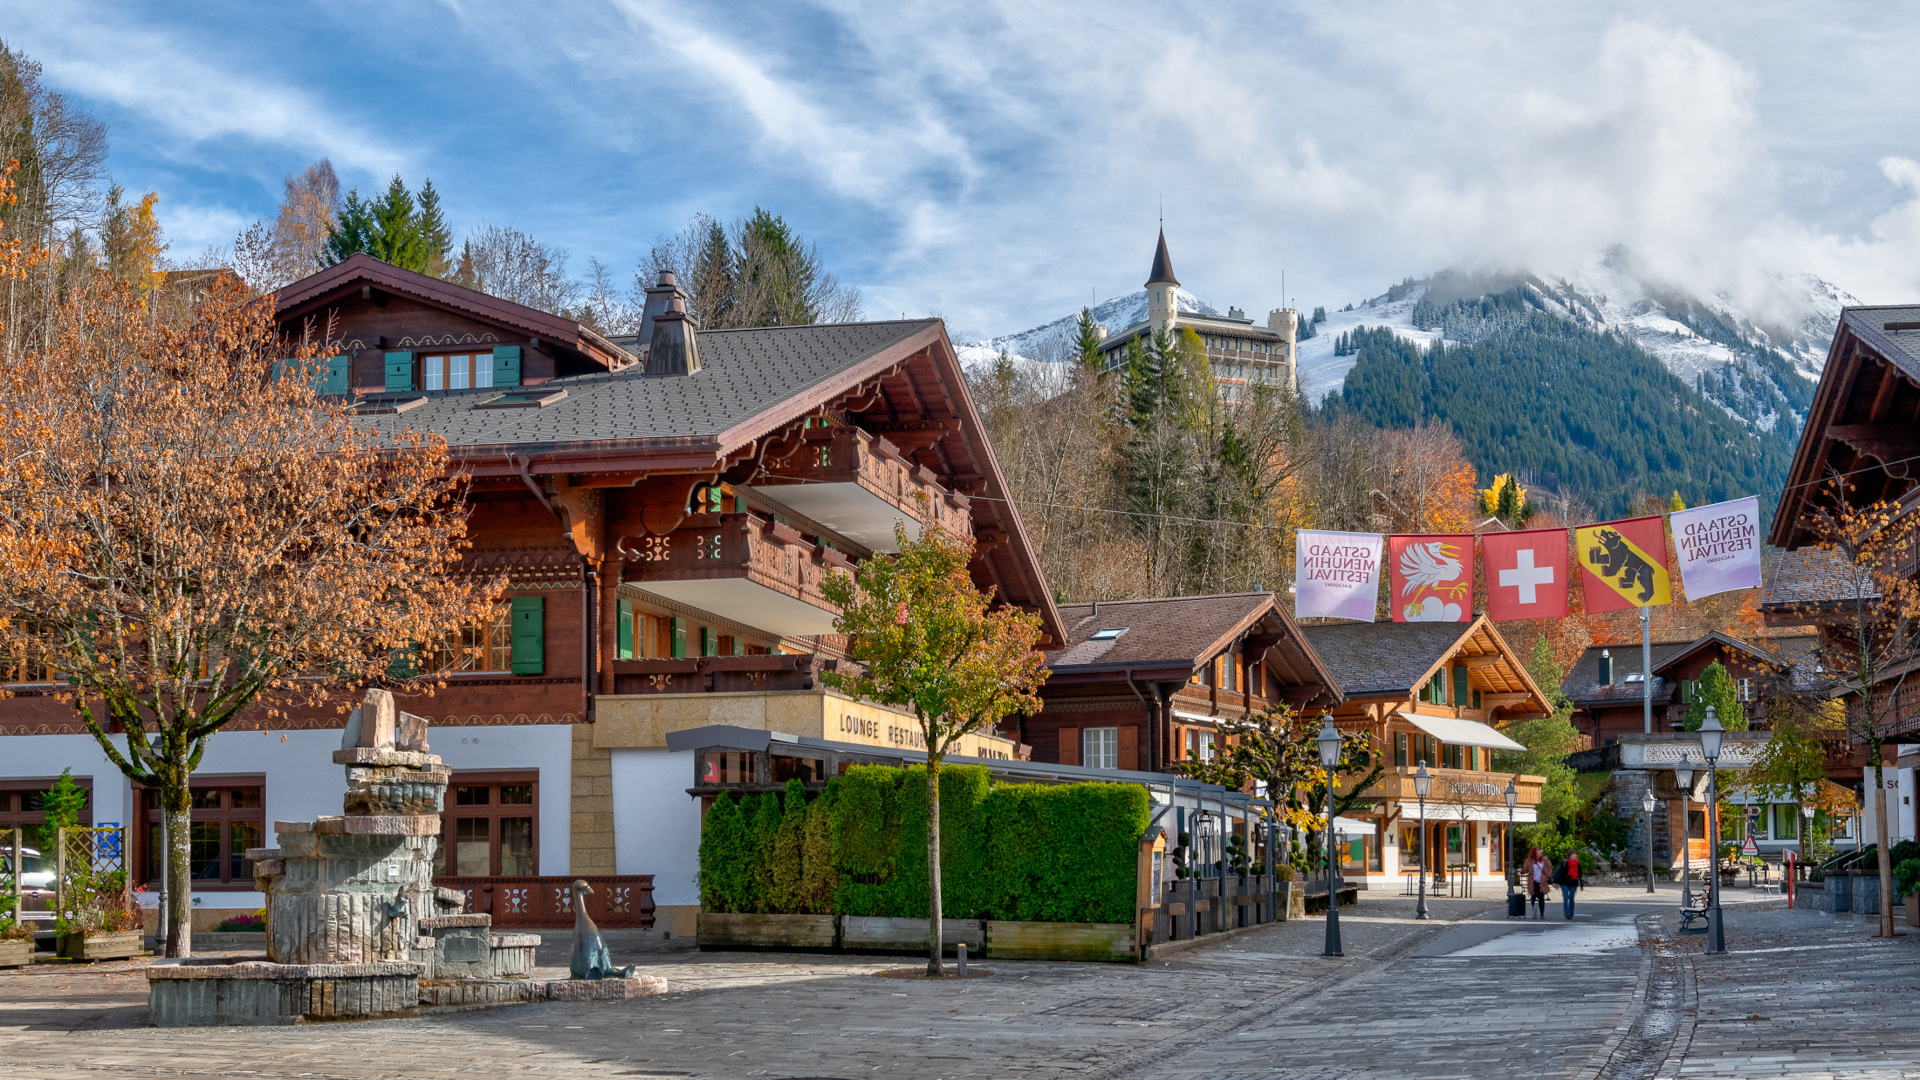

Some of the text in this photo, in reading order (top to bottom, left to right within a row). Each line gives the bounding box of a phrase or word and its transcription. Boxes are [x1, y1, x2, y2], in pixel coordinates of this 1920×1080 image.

[840, 714, 878, 739] LOUNGE
[1451, 781, 1501, 796] LOUIS VUITTON
